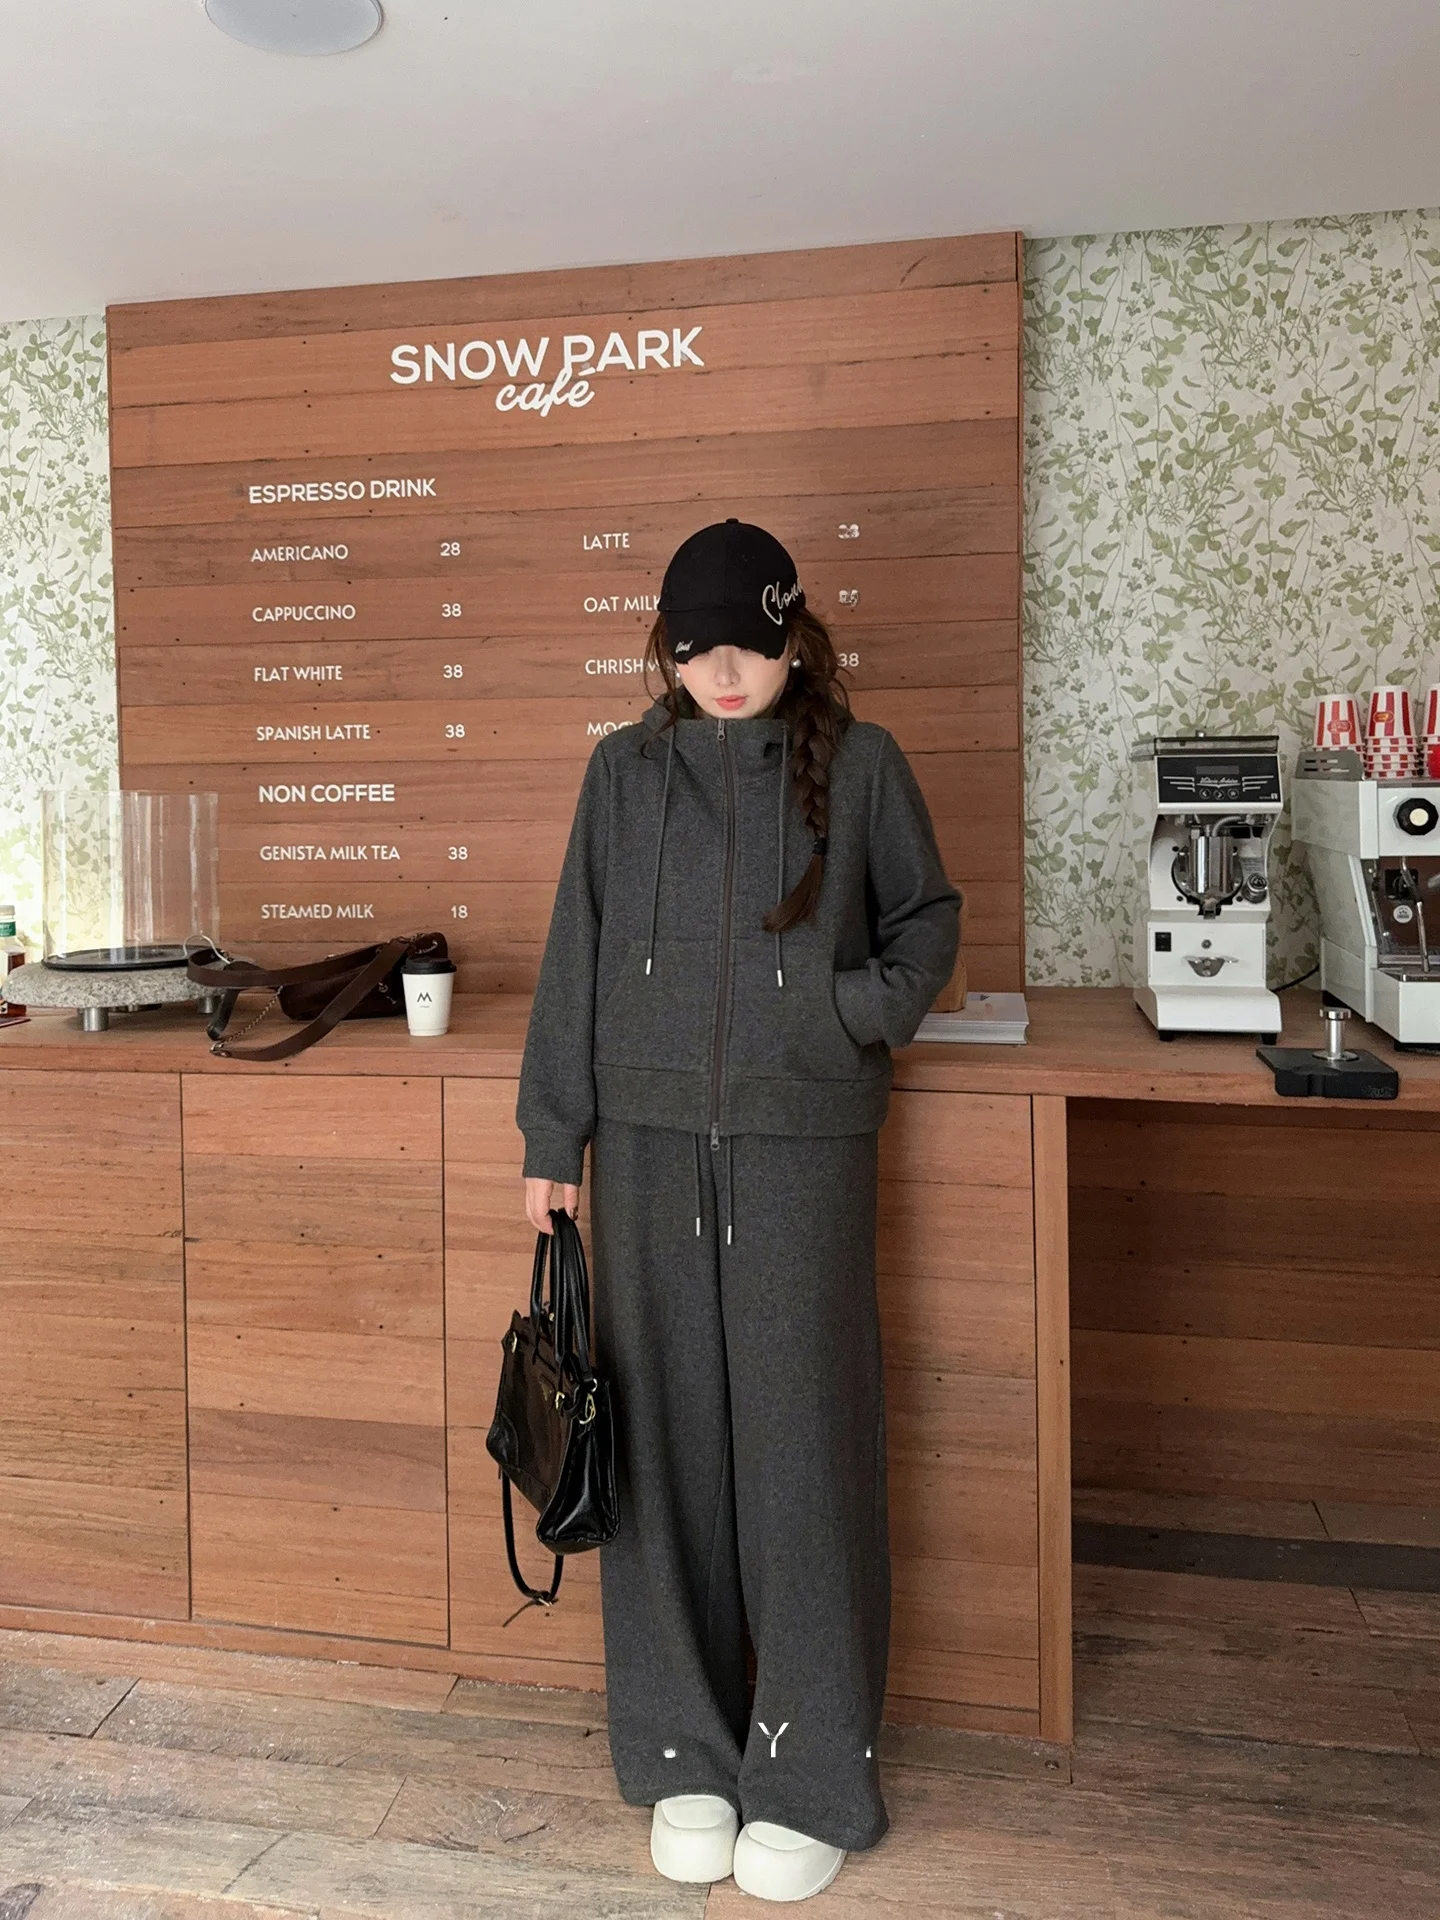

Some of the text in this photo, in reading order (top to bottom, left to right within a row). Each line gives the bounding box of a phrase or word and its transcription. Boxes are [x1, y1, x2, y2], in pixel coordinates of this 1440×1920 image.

[389, 326, 705, 385] SNOW PARK
[496, 367, 596, 418] café
[248, 477, 437, 505] ESPRESSO DRINK
[251, 541, 461, 563] AMERICANO 28
[583, 532, 630, 551] LATTE
[252, 602, 462, 623] CAPPUCCINO 38
[583, 596, 619, 613] OAT
[254, 664, 464, 682] FLAT WHITE 38
[585, 658, 644, 675] CHRISH
[838, 652, 860, 668] 38
[256, 724, 466, 742] SPANISH LATTE 38
[258, 783, 396, 804] NON COFFEE
[259, 844, 469, 861] GENISTA MILK TEA 38
[260, 903, 469, 919] STEAMED MILK 18
